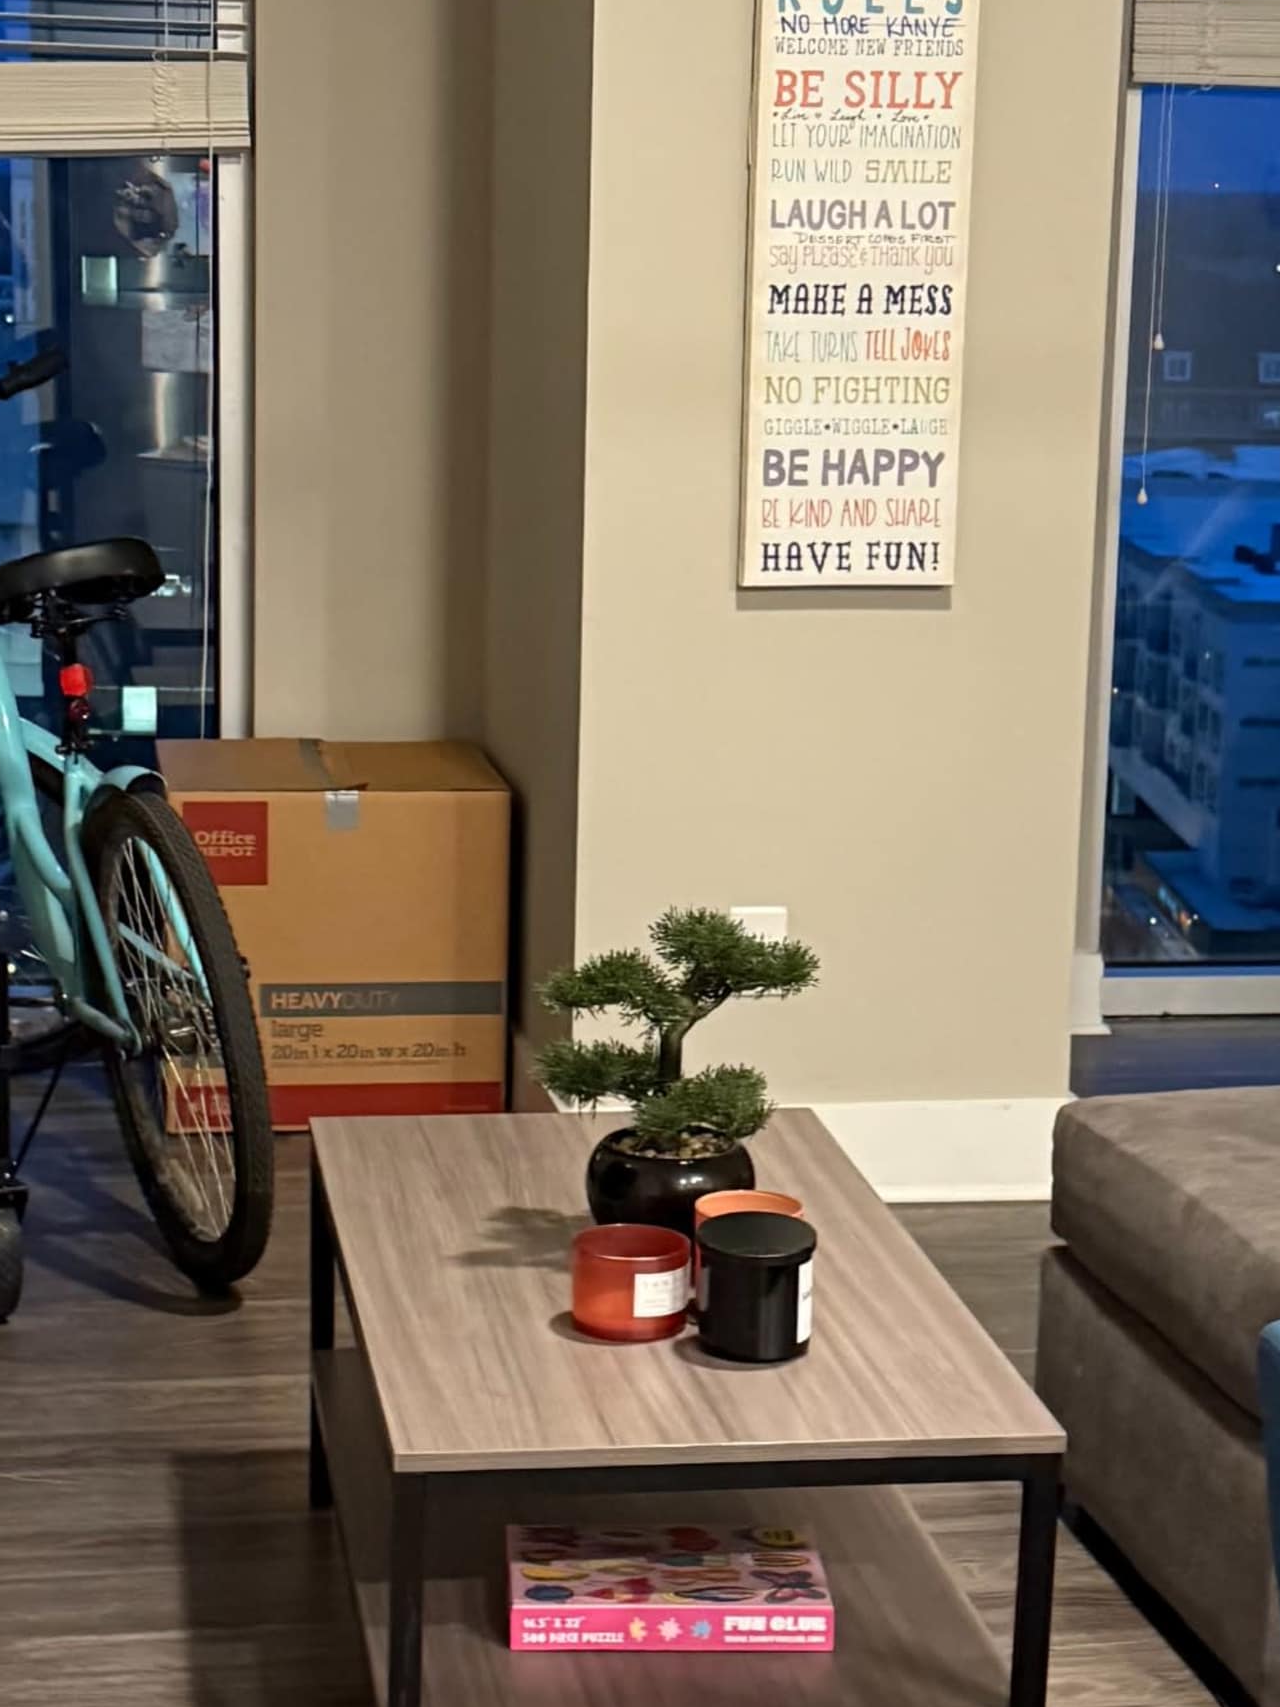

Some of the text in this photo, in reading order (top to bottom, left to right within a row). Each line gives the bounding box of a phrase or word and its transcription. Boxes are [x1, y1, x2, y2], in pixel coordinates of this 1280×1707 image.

[781, 14, 961, 38] NO MORE KANYE
[775, 36, 964, 57] WELCOME NEW FRIENDS
[774, 69, 963, 109] BE SILLY
[780, 108, 920, 129] Live Laugh Love
[772, 124, 961, 150] LET YOUR IMAGINATION
[771, 158, 952, 184] RUN WILD SMILE
[770, 199, 956, 230] LAUGH A LOT
[793, 232, 865, 245] DESSERT
[910, 233, 957, 244] FIRST
[768, 283, 953, 316] MAKE A MESS
[765, 327, 951, 363] TAKE TURNS TELL JOKES
[765, 376, 951, 404] NO FIGHTING
[764, 418, 823, 436] GIGGLE
[832, 418, 890, 436] WIGGLE
[763, 448, 945, 488] BE HAPPY
[762, 498, 941, 528] BE KIND AND SHARE
[761, 541, 940, 574] HAVE FUN!
[194, 830, 256, 845] Office
[271, 1020, 324, 1041] large
